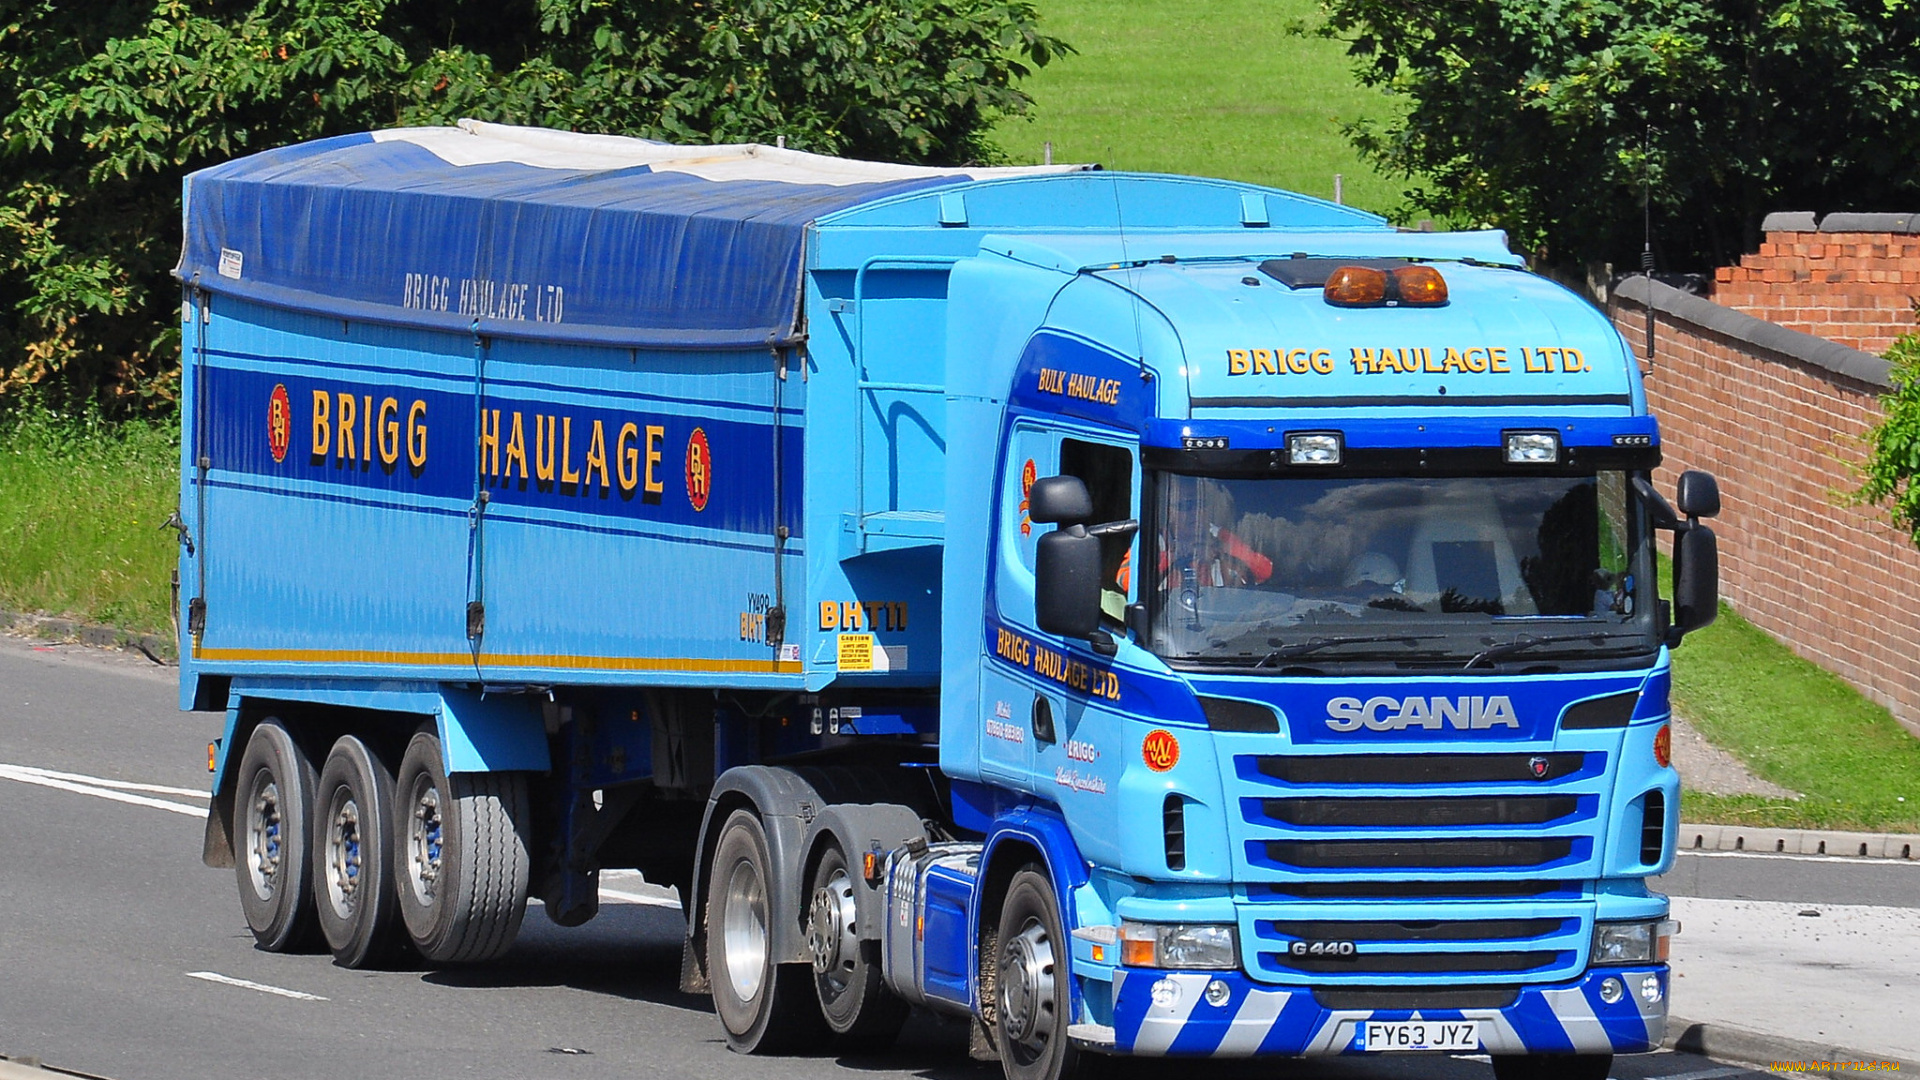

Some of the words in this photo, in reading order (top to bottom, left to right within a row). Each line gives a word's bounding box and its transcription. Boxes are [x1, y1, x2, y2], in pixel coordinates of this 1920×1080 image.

[403, 272, 450, 312] BRIGG
[459, 279, 529, 322] HAULAGE
[536, 284, 564, 324] LTD
[1227, 347, 1335, 375] BRIGG
[1350, 347, 1511, 374] HAULAGE
[1521, 346, 1593, 374] LTD.
[1038, 367, 1067, 395] BULK
[1067, 373, 1122, 405] HAULAGE
[312, 389, 428, 469] BRIGG
[479, 408, 665, 494] HAULAGE
[819, 601, 908, 632] BHT11
[996, 627, 1031, 667] BRIGG
[1034, 644, 1089, 691] HAULAGE
[1092, 667, 1122, 701] LTD.
[1325, 696, 1520, 732] SCANIA
[1292, 942, 1307, 956] G
[1309, 941, 1354, 956] 440
[1368, 1024, 1426, 1047] FY63
[1433, 1024, 1475, 1046] JYZ
